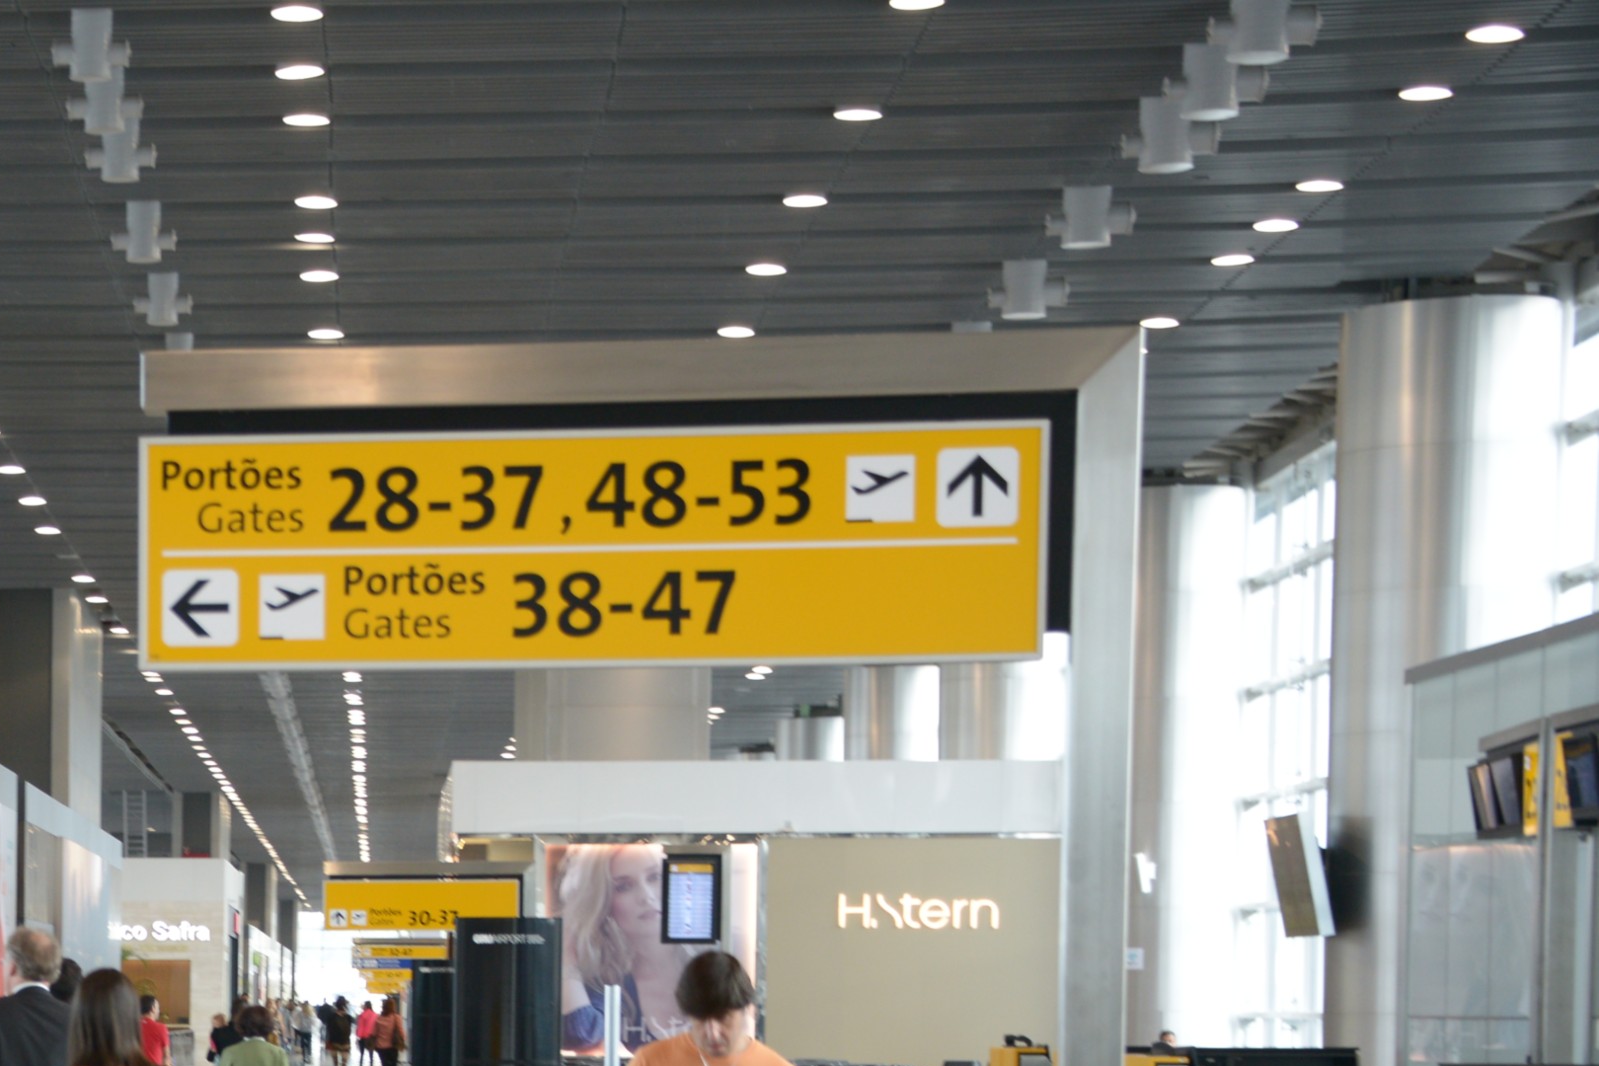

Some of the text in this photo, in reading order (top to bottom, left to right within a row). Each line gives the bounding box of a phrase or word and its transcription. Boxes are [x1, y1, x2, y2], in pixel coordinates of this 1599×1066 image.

[160, 458, 302, 491] Portões
[585, 458, 812, 528] 48-53
[197, 501, 304, 534] Gates
[343, 563, 486, 596] Portões
[512, 570, 737, 638] 38-47
[343, 607, 452, 640] Gates
[151, 920, 210, 941] Safra
